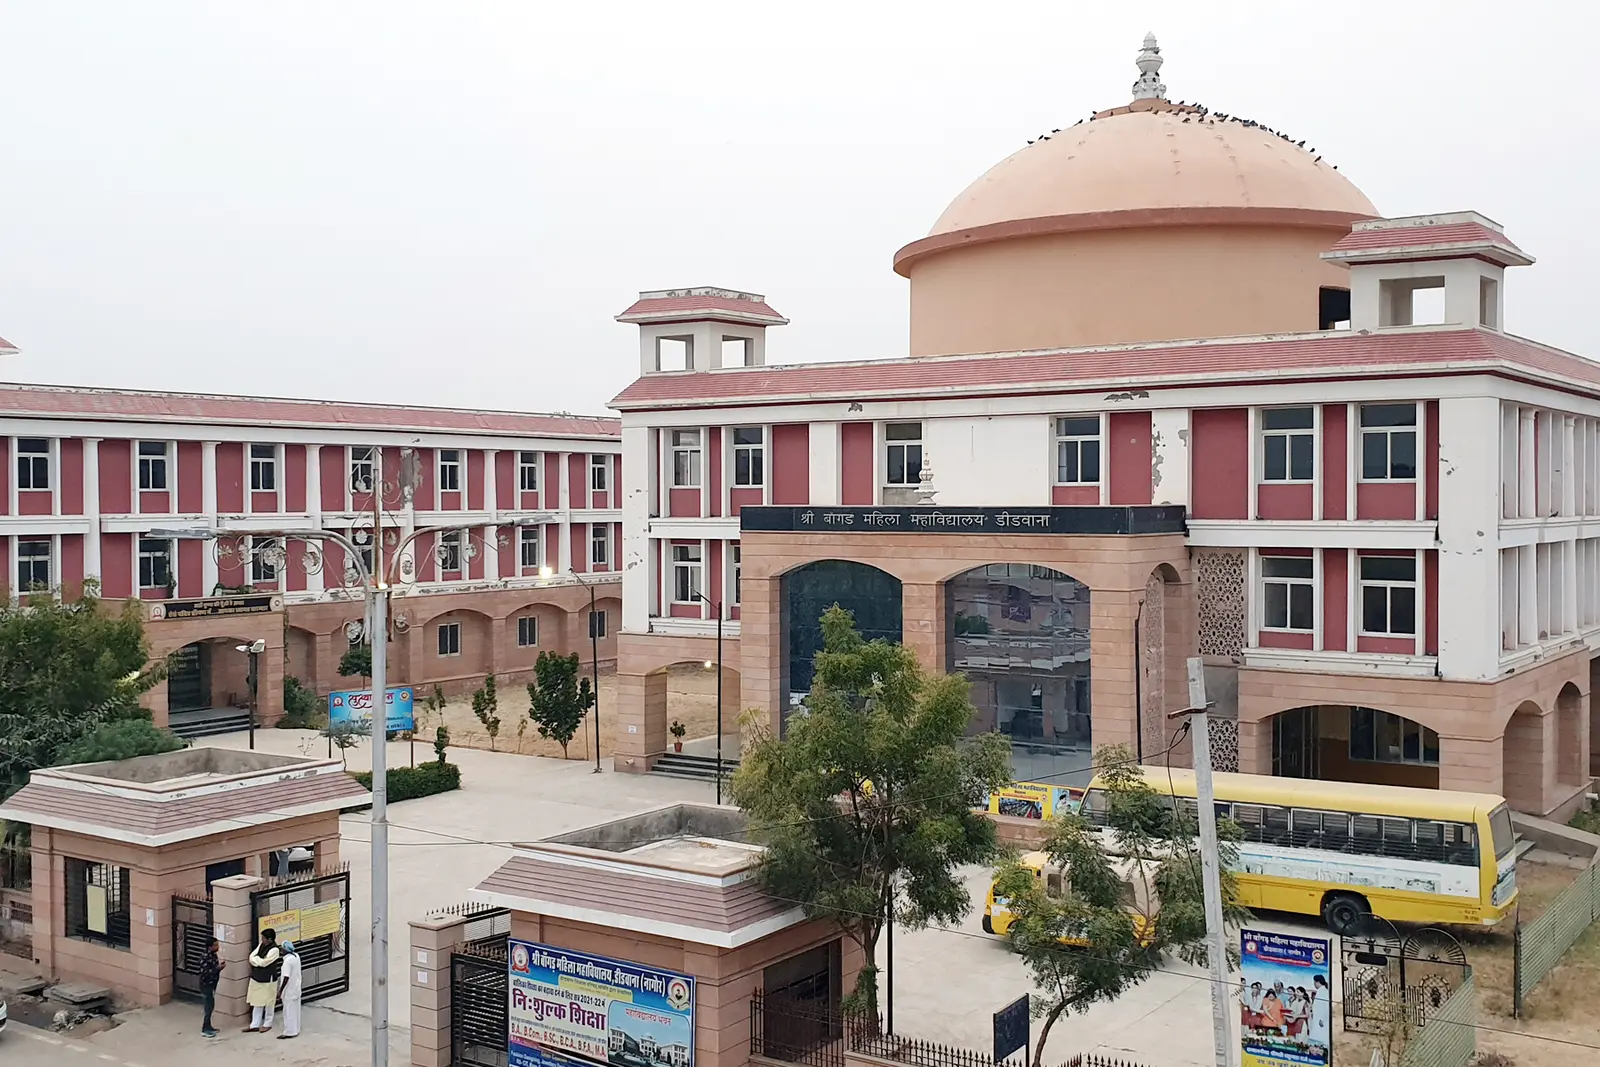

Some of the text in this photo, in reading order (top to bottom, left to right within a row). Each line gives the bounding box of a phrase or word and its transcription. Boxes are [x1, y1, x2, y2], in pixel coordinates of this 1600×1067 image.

[800, 510, 815, 525] श्री
[863, 510, 901, 526] महिला
[909, 510, 985, 527] महाविद्यालय
[994, 510, 1051, 527] डीडवाना
[531, 950, 541, 967] श्री
[556, 956, 576, 974] महिला
[580, 994, 602, 1006] 2021-22
[569, 1001, 606, 1031] शिक्षा
